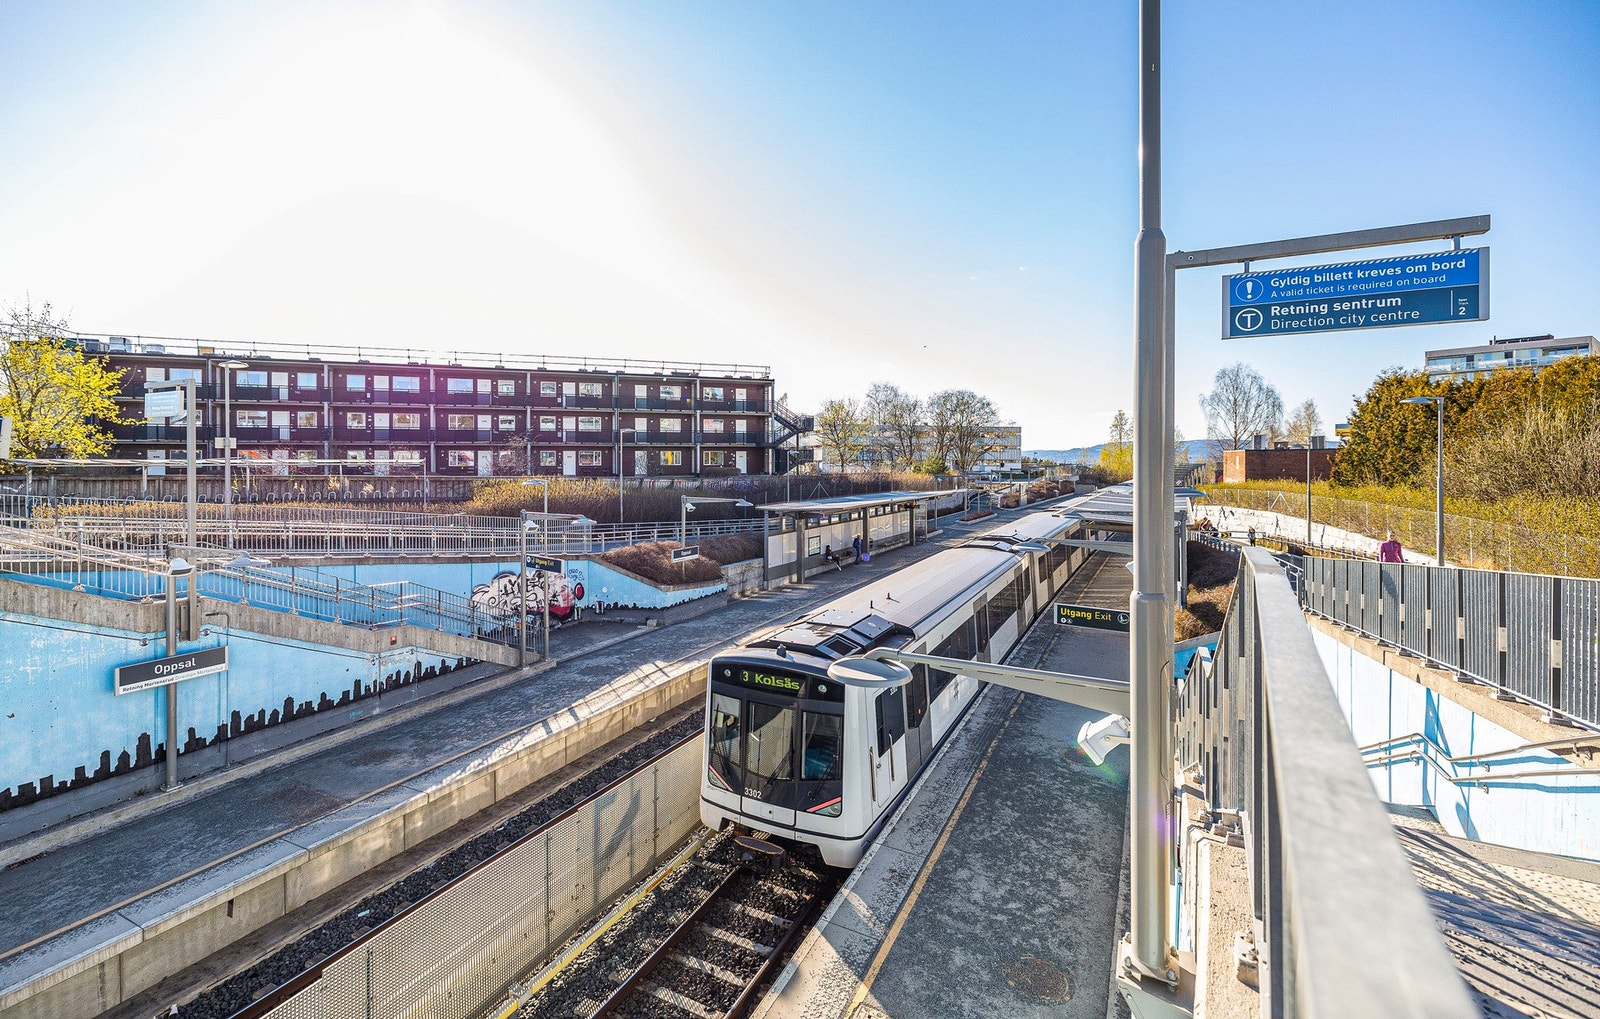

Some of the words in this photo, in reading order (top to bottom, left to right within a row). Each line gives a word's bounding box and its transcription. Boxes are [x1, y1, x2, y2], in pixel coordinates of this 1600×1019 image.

[1271, 275, 1310, 288] Gyldig
[1314, 271, 1353, 282] billett
[1357, 267, 1401, 278] kreves
[1406, 264, 1427, 273] om
[1432, 259, 1466, 271] bord
[1280, 288, 1303, 297] valid
[1306, 285, 1334, 295] ticket
[1348, 279, 1393, 291] required
[1413, 274, 1446, 284] board
[1271, 303, 1329, 316] Retning
[1333, 297, 1402, 311] sentrum
[1458, 306, 1466, 315] 2
[1271, 316, 1334, 330] Direction
[1340, 313, 1366, 326] city
[1371, 310, 1420, 322] centre
[1060, 607, 1092, 620] Utgang
[1095, 611, 1111, 622] Exit
[154, 657, 196, 675] Oppsal
[122, 684, 144, 693] Retning
[742, 671, 749, 682] 3
[755, 673, 800, 690] Kolsås
[744, 787, 762, 799] 3302
